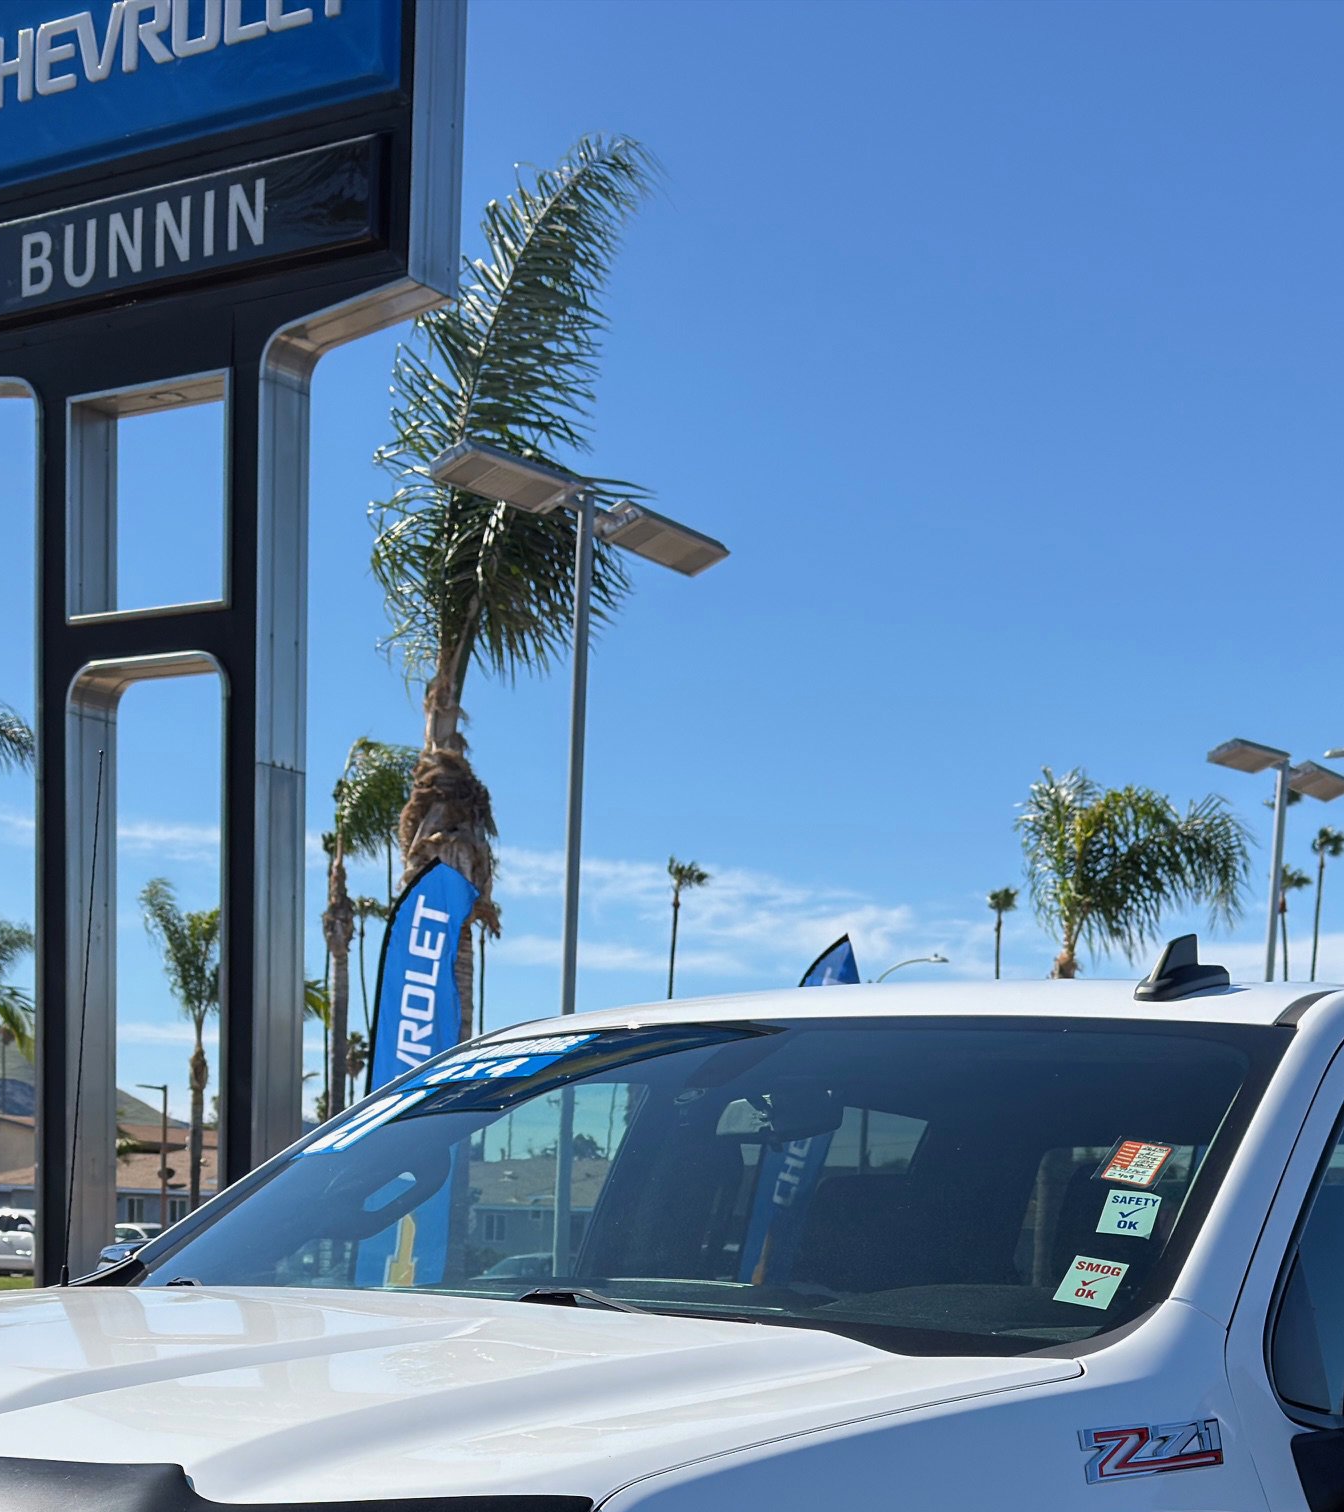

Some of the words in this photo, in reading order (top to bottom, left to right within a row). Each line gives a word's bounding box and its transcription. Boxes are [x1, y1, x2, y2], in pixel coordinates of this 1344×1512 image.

[21, 177, 265, 298] BUNNIN
[1111, 1194, 1159, 1207] SAFETY
[1116, 1220, 1139, 1231] OK
[1075, 1260, 1123, 1277] SMOG
[1074, 1287, 1098, 1300] OK
[1077, 1418, 1225, 1485] Z71
